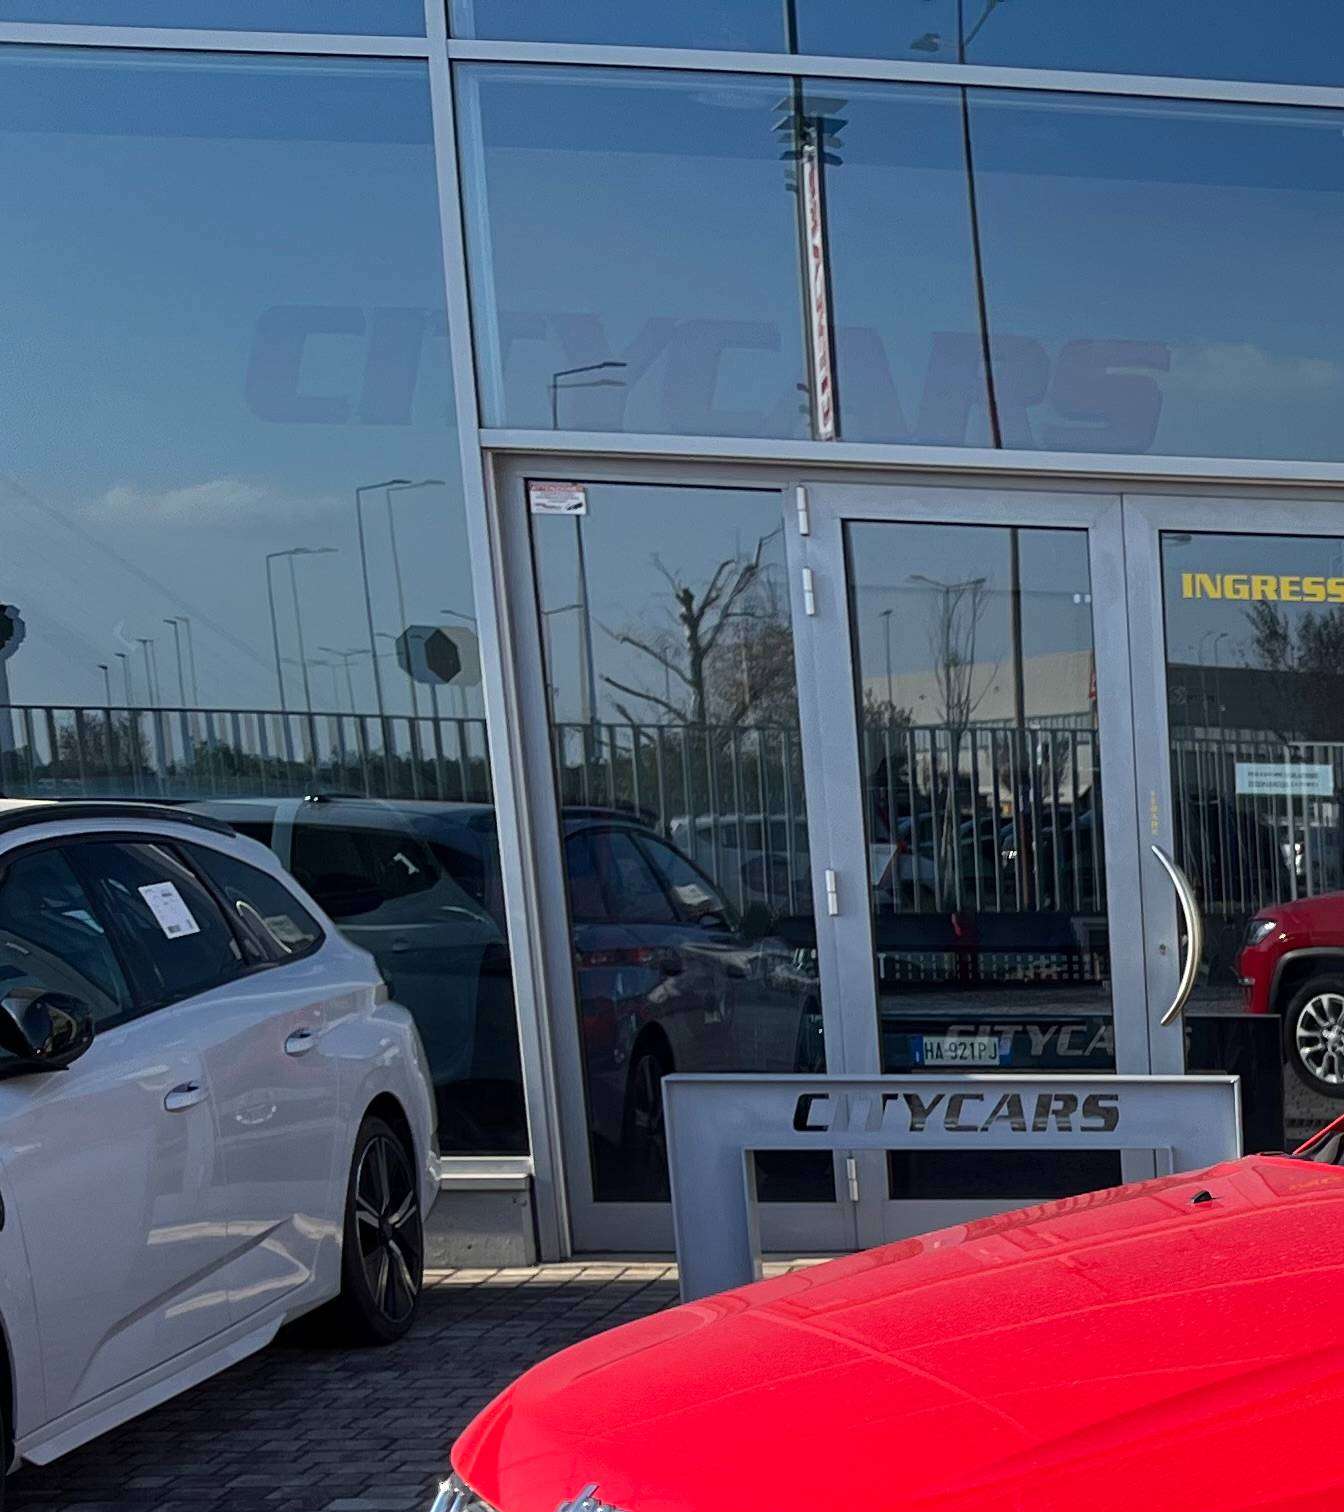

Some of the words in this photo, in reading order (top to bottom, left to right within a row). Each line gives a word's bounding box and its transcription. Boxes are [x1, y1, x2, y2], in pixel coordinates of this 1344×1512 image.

[244, 304, 1171, 455] CITYCARS
[924, 1042, 943, 1060] HA
[793, 1093, 1120, 1132] CITYCARS
